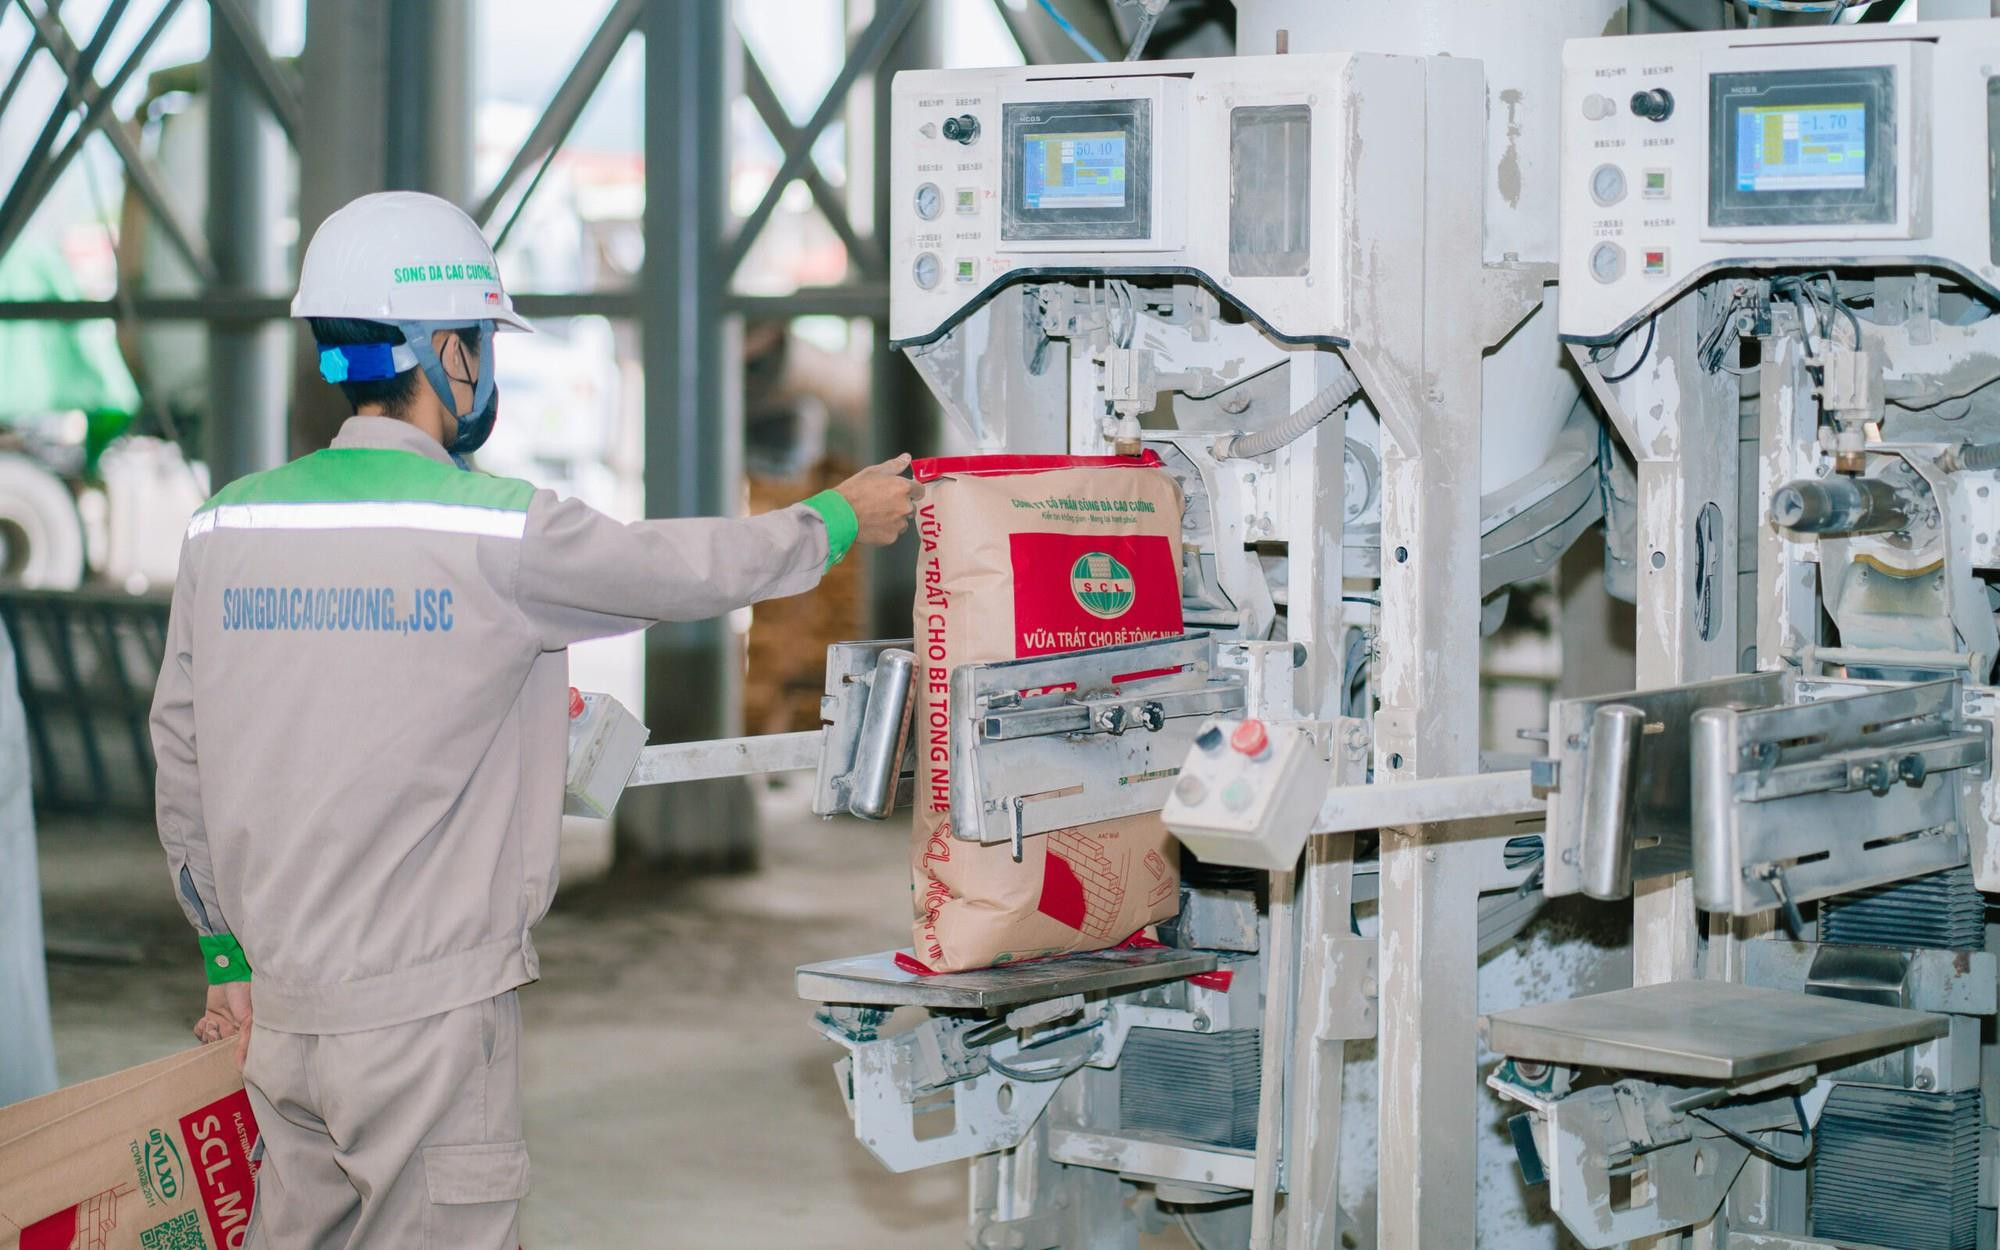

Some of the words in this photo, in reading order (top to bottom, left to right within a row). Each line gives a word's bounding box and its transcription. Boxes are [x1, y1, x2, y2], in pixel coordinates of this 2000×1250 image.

[394, 268, 426, 283] SONG
[429, 266, 443, 281] DA
[446, 265, 464, 280] CAO
[919, 504, 941, 552] VỮA
[925, 557, 952, 609] TRÁT
[928, 614, 946, 661] CHO
[1023, 628, 1056, 649] VỮA
[1057, 626, 1087, 648] TRÁT
[1089, 631, 1112, 647] CHO
